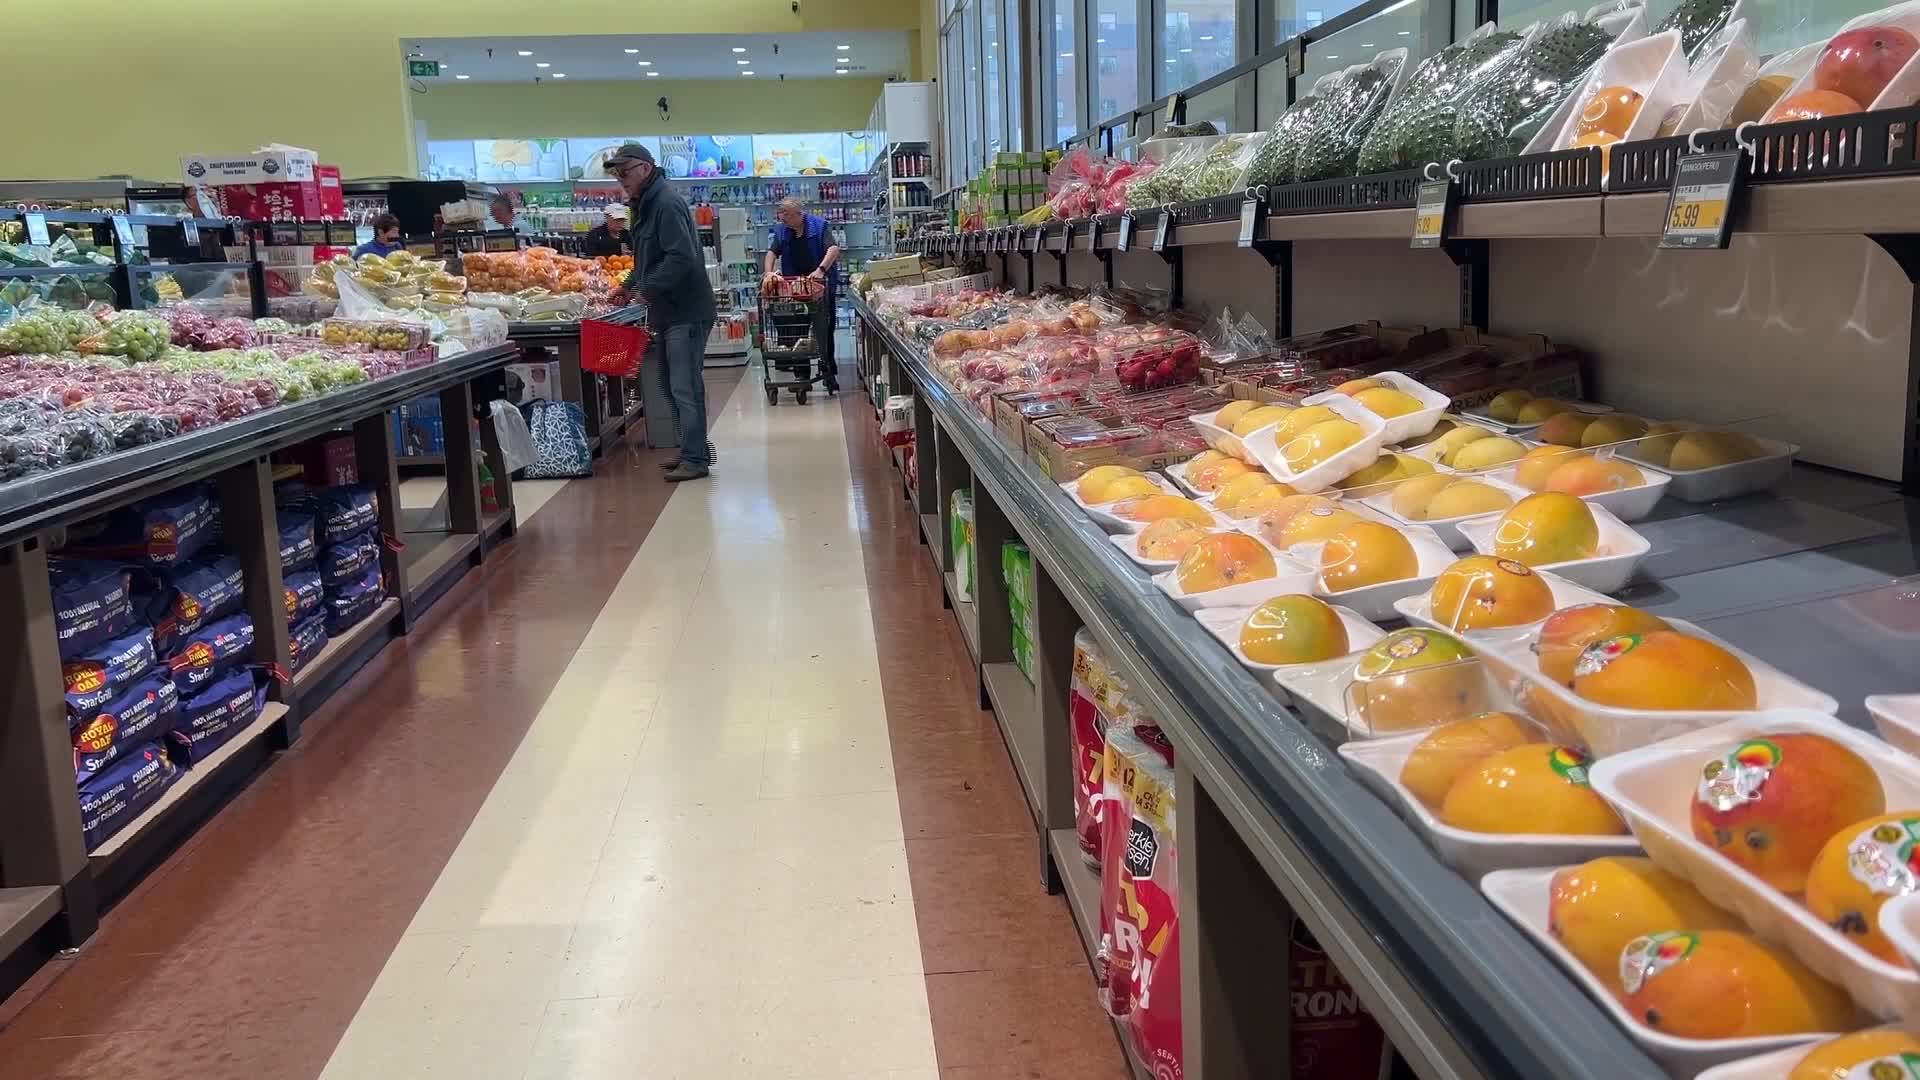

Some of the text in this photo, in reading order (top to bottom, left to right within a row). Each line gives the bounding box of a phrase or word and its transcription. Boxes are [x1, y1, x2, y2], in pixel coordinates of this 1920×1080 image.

[1672, 203, 1700, 228] 5.99
[65, 667, 98, 686] ROYAL
[76, 676, 101, 692] OAK
[76, 687, 113, 710] StarGrill
[231, 690, 253, 709] CHARBON
[80, 722, 115, 743] ROYAL
[91, 737, 112, 750] OAK
[132, 759, 160, 783] CHARBON
[1123, 767, 1136, 787] 12
[101, 782, 126, 804] NATURAL
[100, 799, 127, 821] CHARCOAL
[1129, 829, 1153, 854] erkle
[1157, 1047, 1183, 1077] SEPTIC
